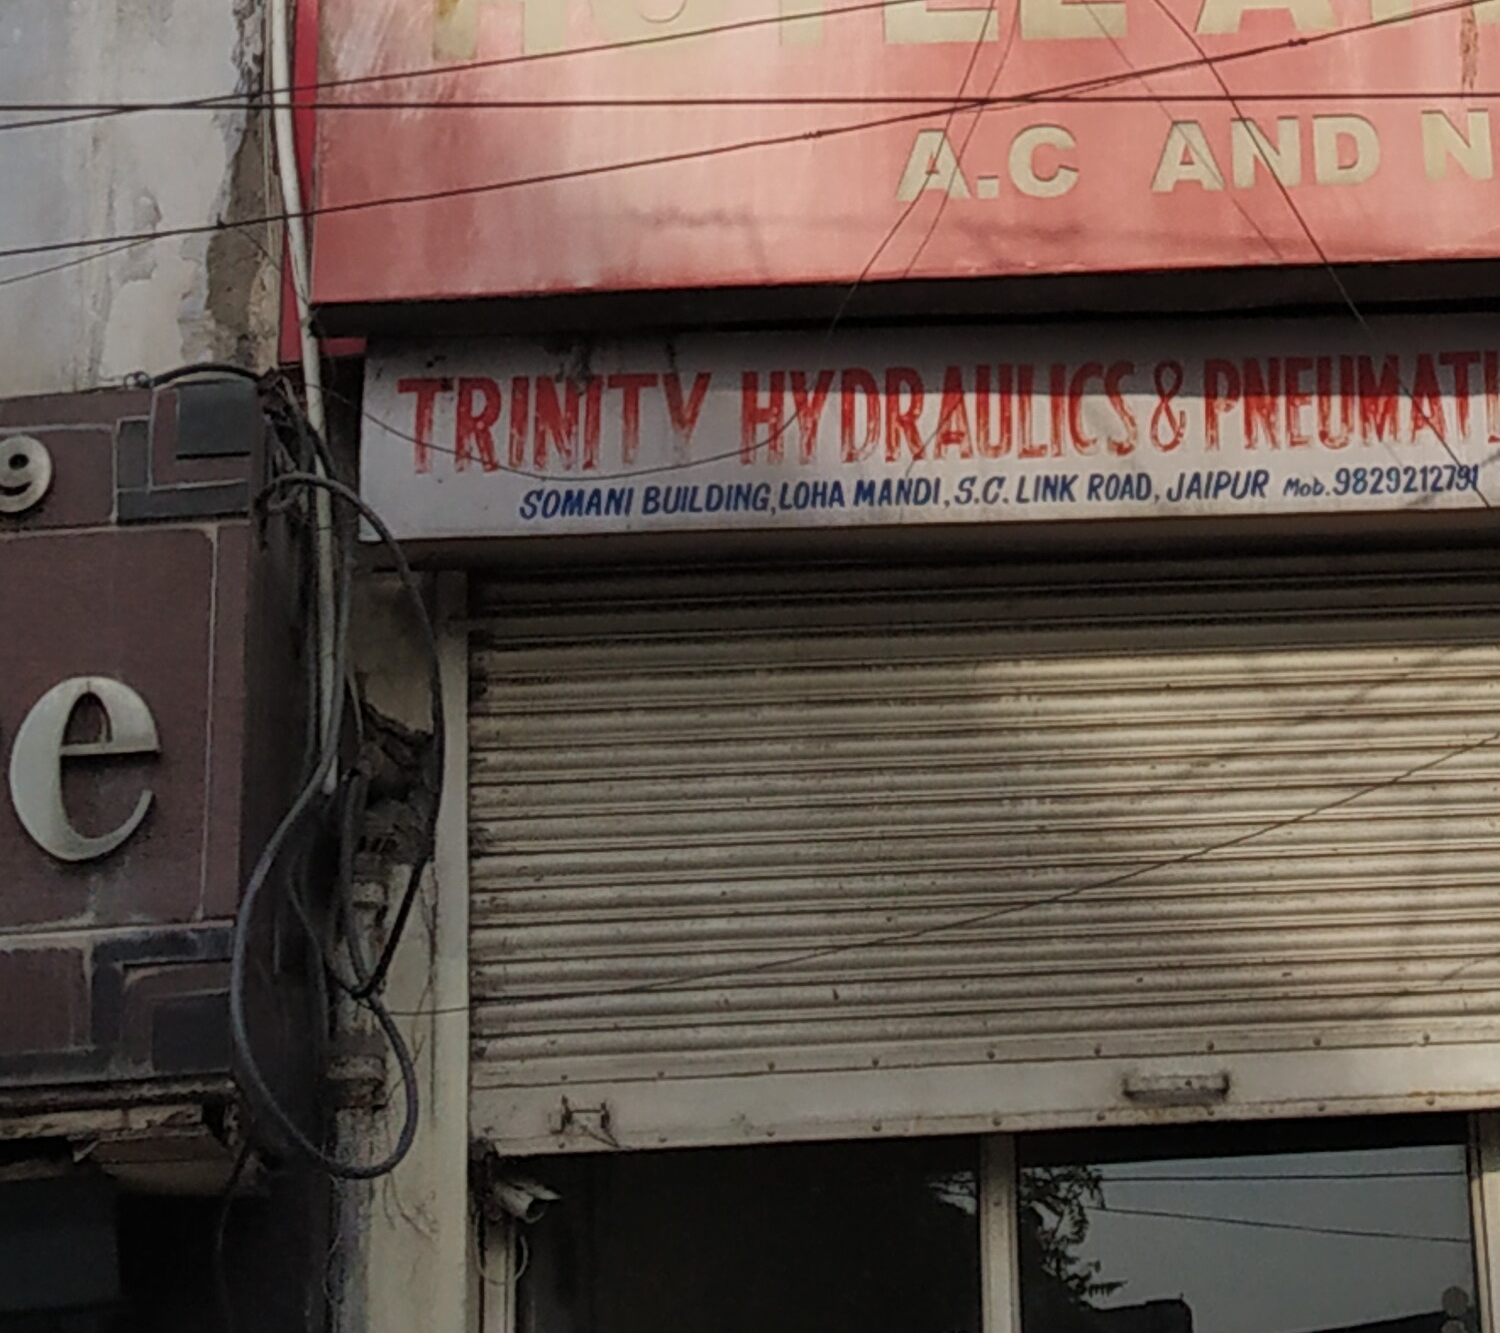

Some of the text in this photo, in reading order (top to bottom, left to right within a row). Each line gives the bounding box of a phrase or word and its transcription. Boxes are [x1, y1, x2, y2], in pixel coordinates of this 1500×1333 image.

[894, 125, 1082, 203] A.C
[1151, 114, 1382, 195] AND
[397, 371, 712, 475] TRINITY
[740, 359, 1138, 467] HYDRAULICS
[1152, 358, 1187, 453] &
[519, 487, 634, 520] SOMANI
[1016, 473, 1081, 504] LINK
[1087, 471, 1161, 503] ROAD,
[1166, 468, 1271, 503] JAIPUR
[10, 676, 162, 862] e
